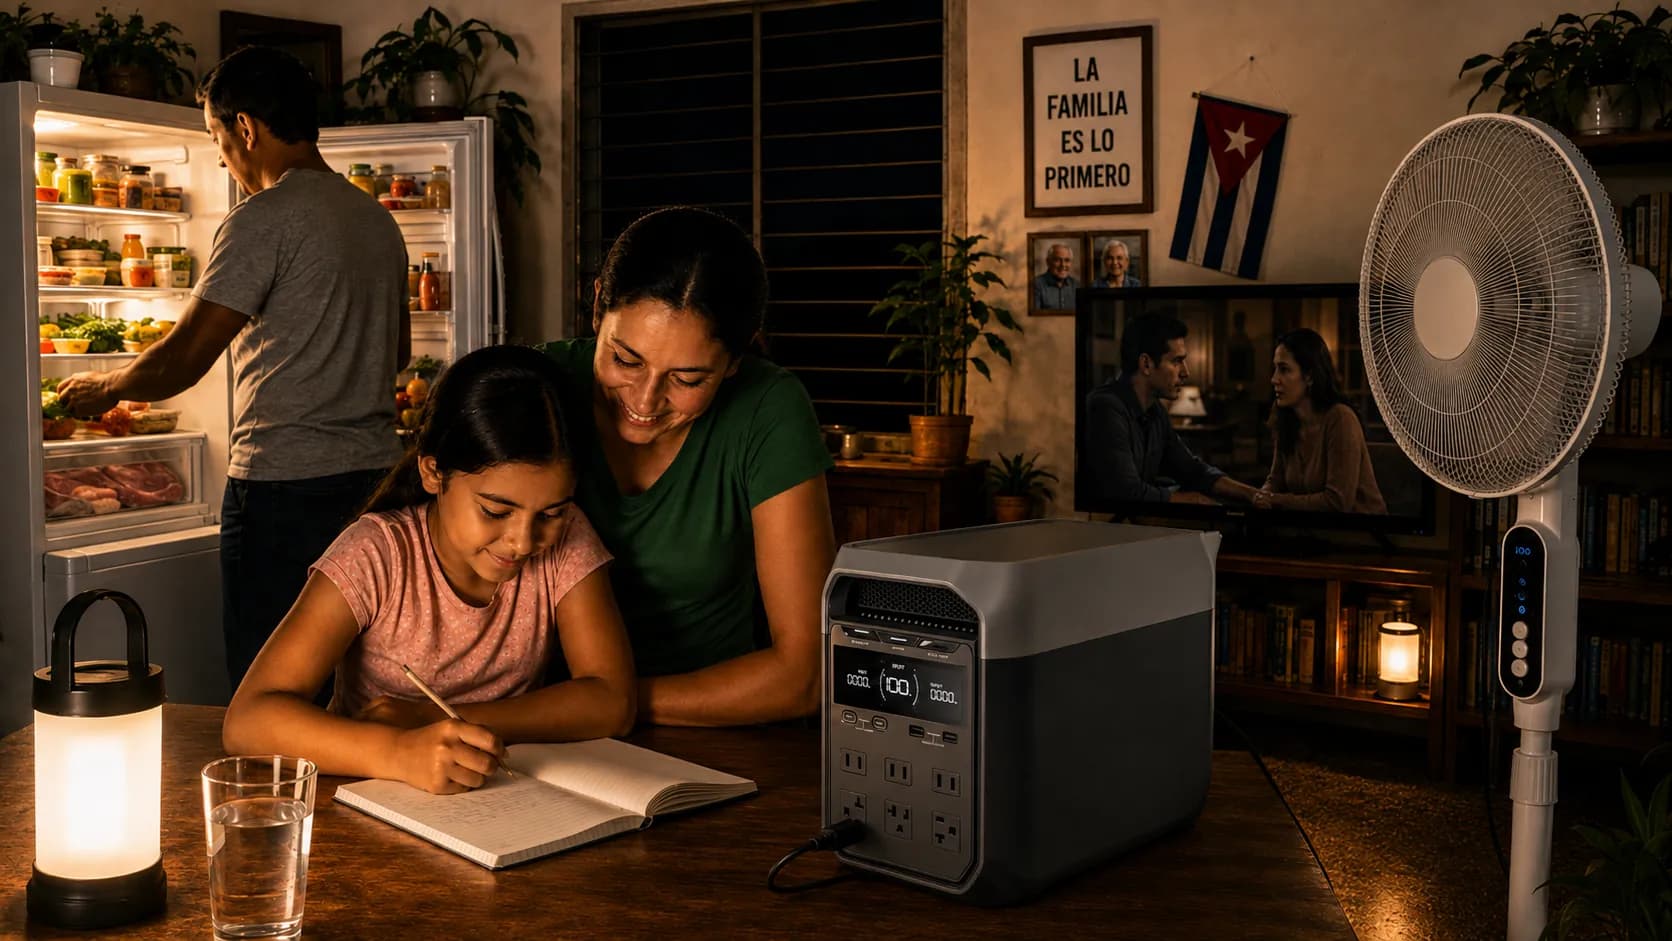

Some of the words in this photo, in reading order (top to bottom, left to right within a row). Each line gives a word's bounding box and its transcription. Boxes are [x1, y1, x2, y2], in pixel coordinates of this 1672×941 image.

[1073, 57, 1100, 82] LA
[1047, 91, 1128, 120] FAMILIA
[1061, 129, 1084, 154] ES
[1091, 128, 1114, 152] LO
[1045, 163, 1131, 190] PRIMERO
[1515, 546, 1531, 556] 100
